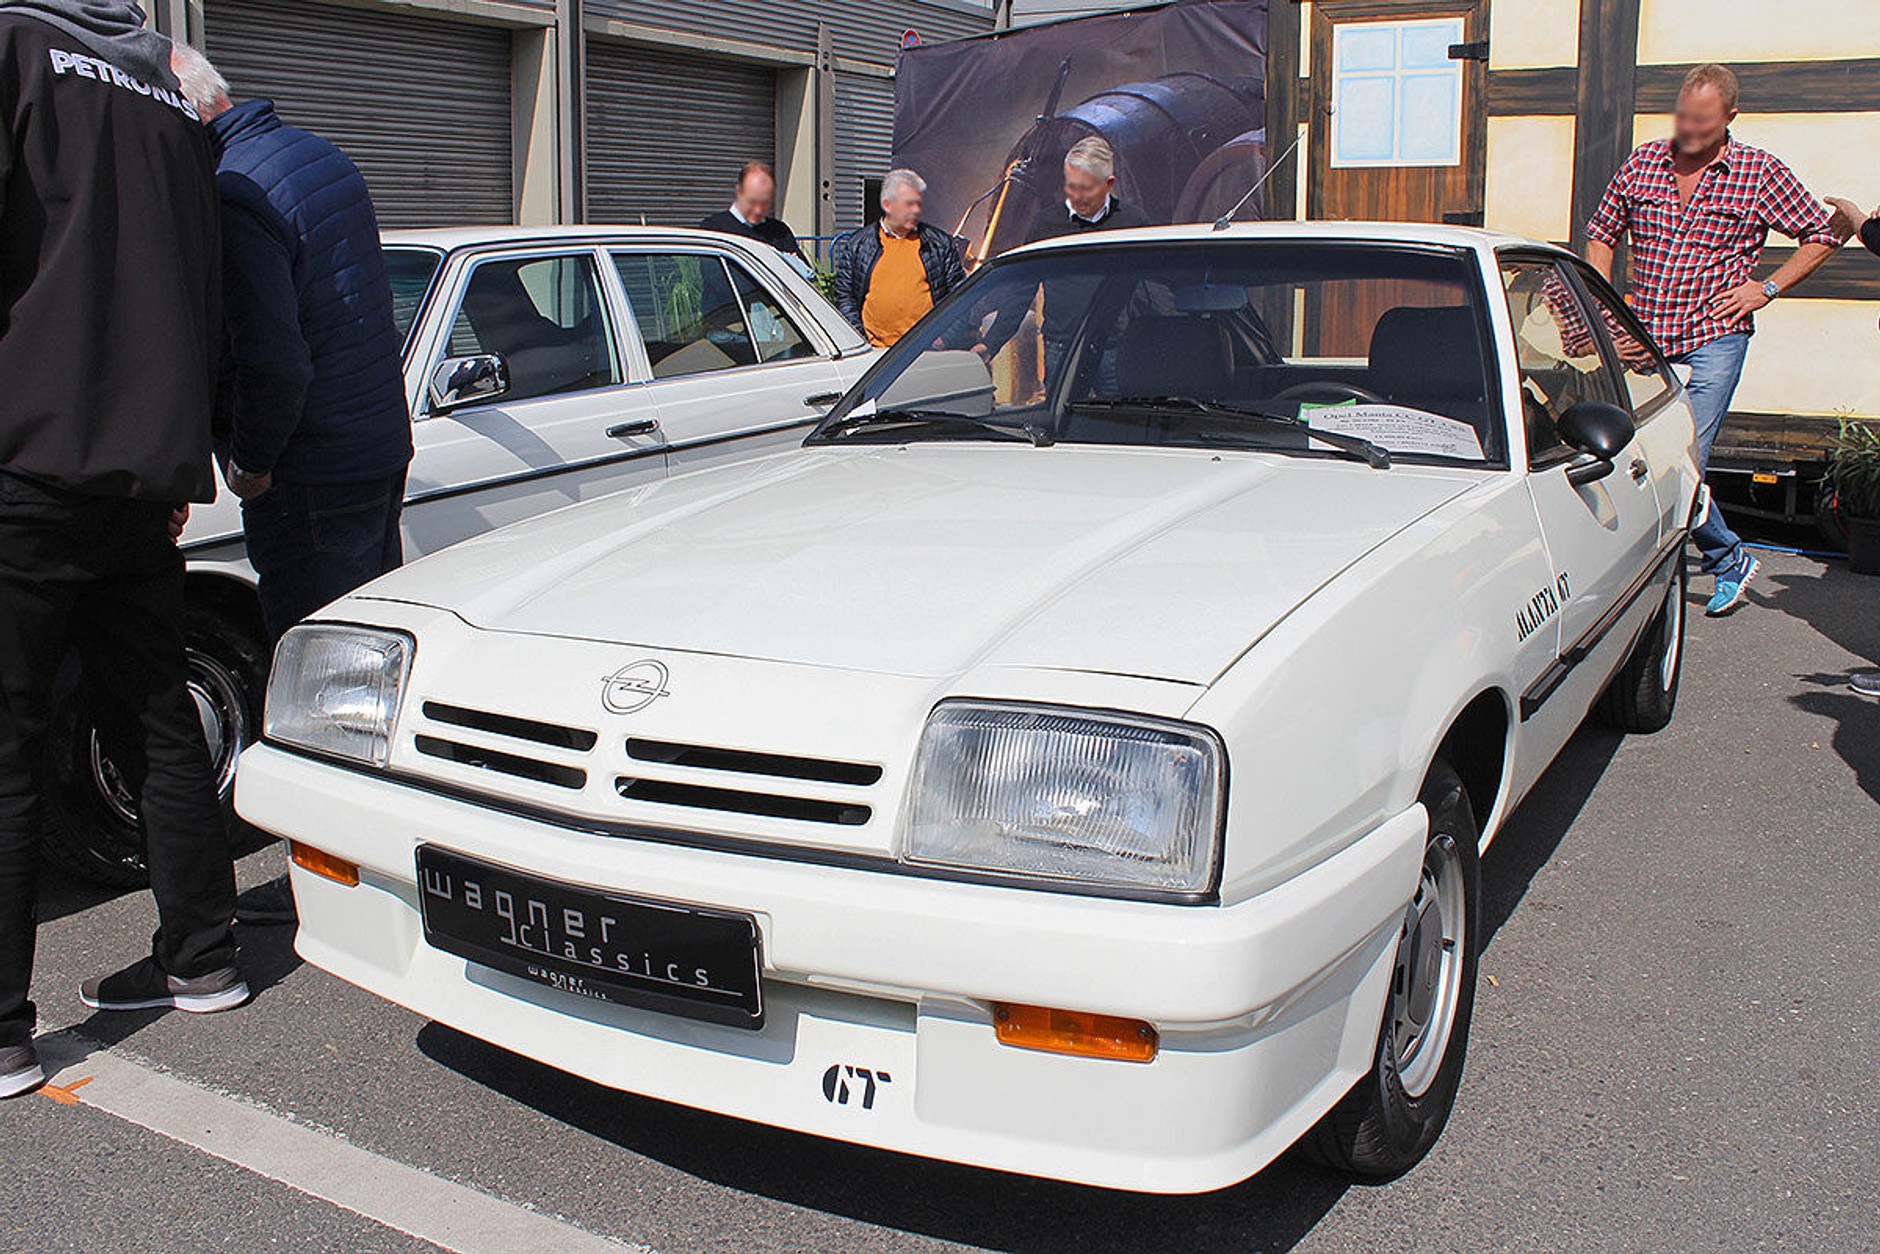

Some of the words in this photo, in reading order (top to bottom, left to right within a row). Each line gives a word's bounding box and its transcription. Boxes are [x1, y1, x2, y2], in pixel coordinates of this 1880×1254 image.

[426, 866, 616, 946] wagner
[519, 924, 710, 987] classics
[527, 965, 585, 988] wagner
[822, 1063, 892, 1110] GT
